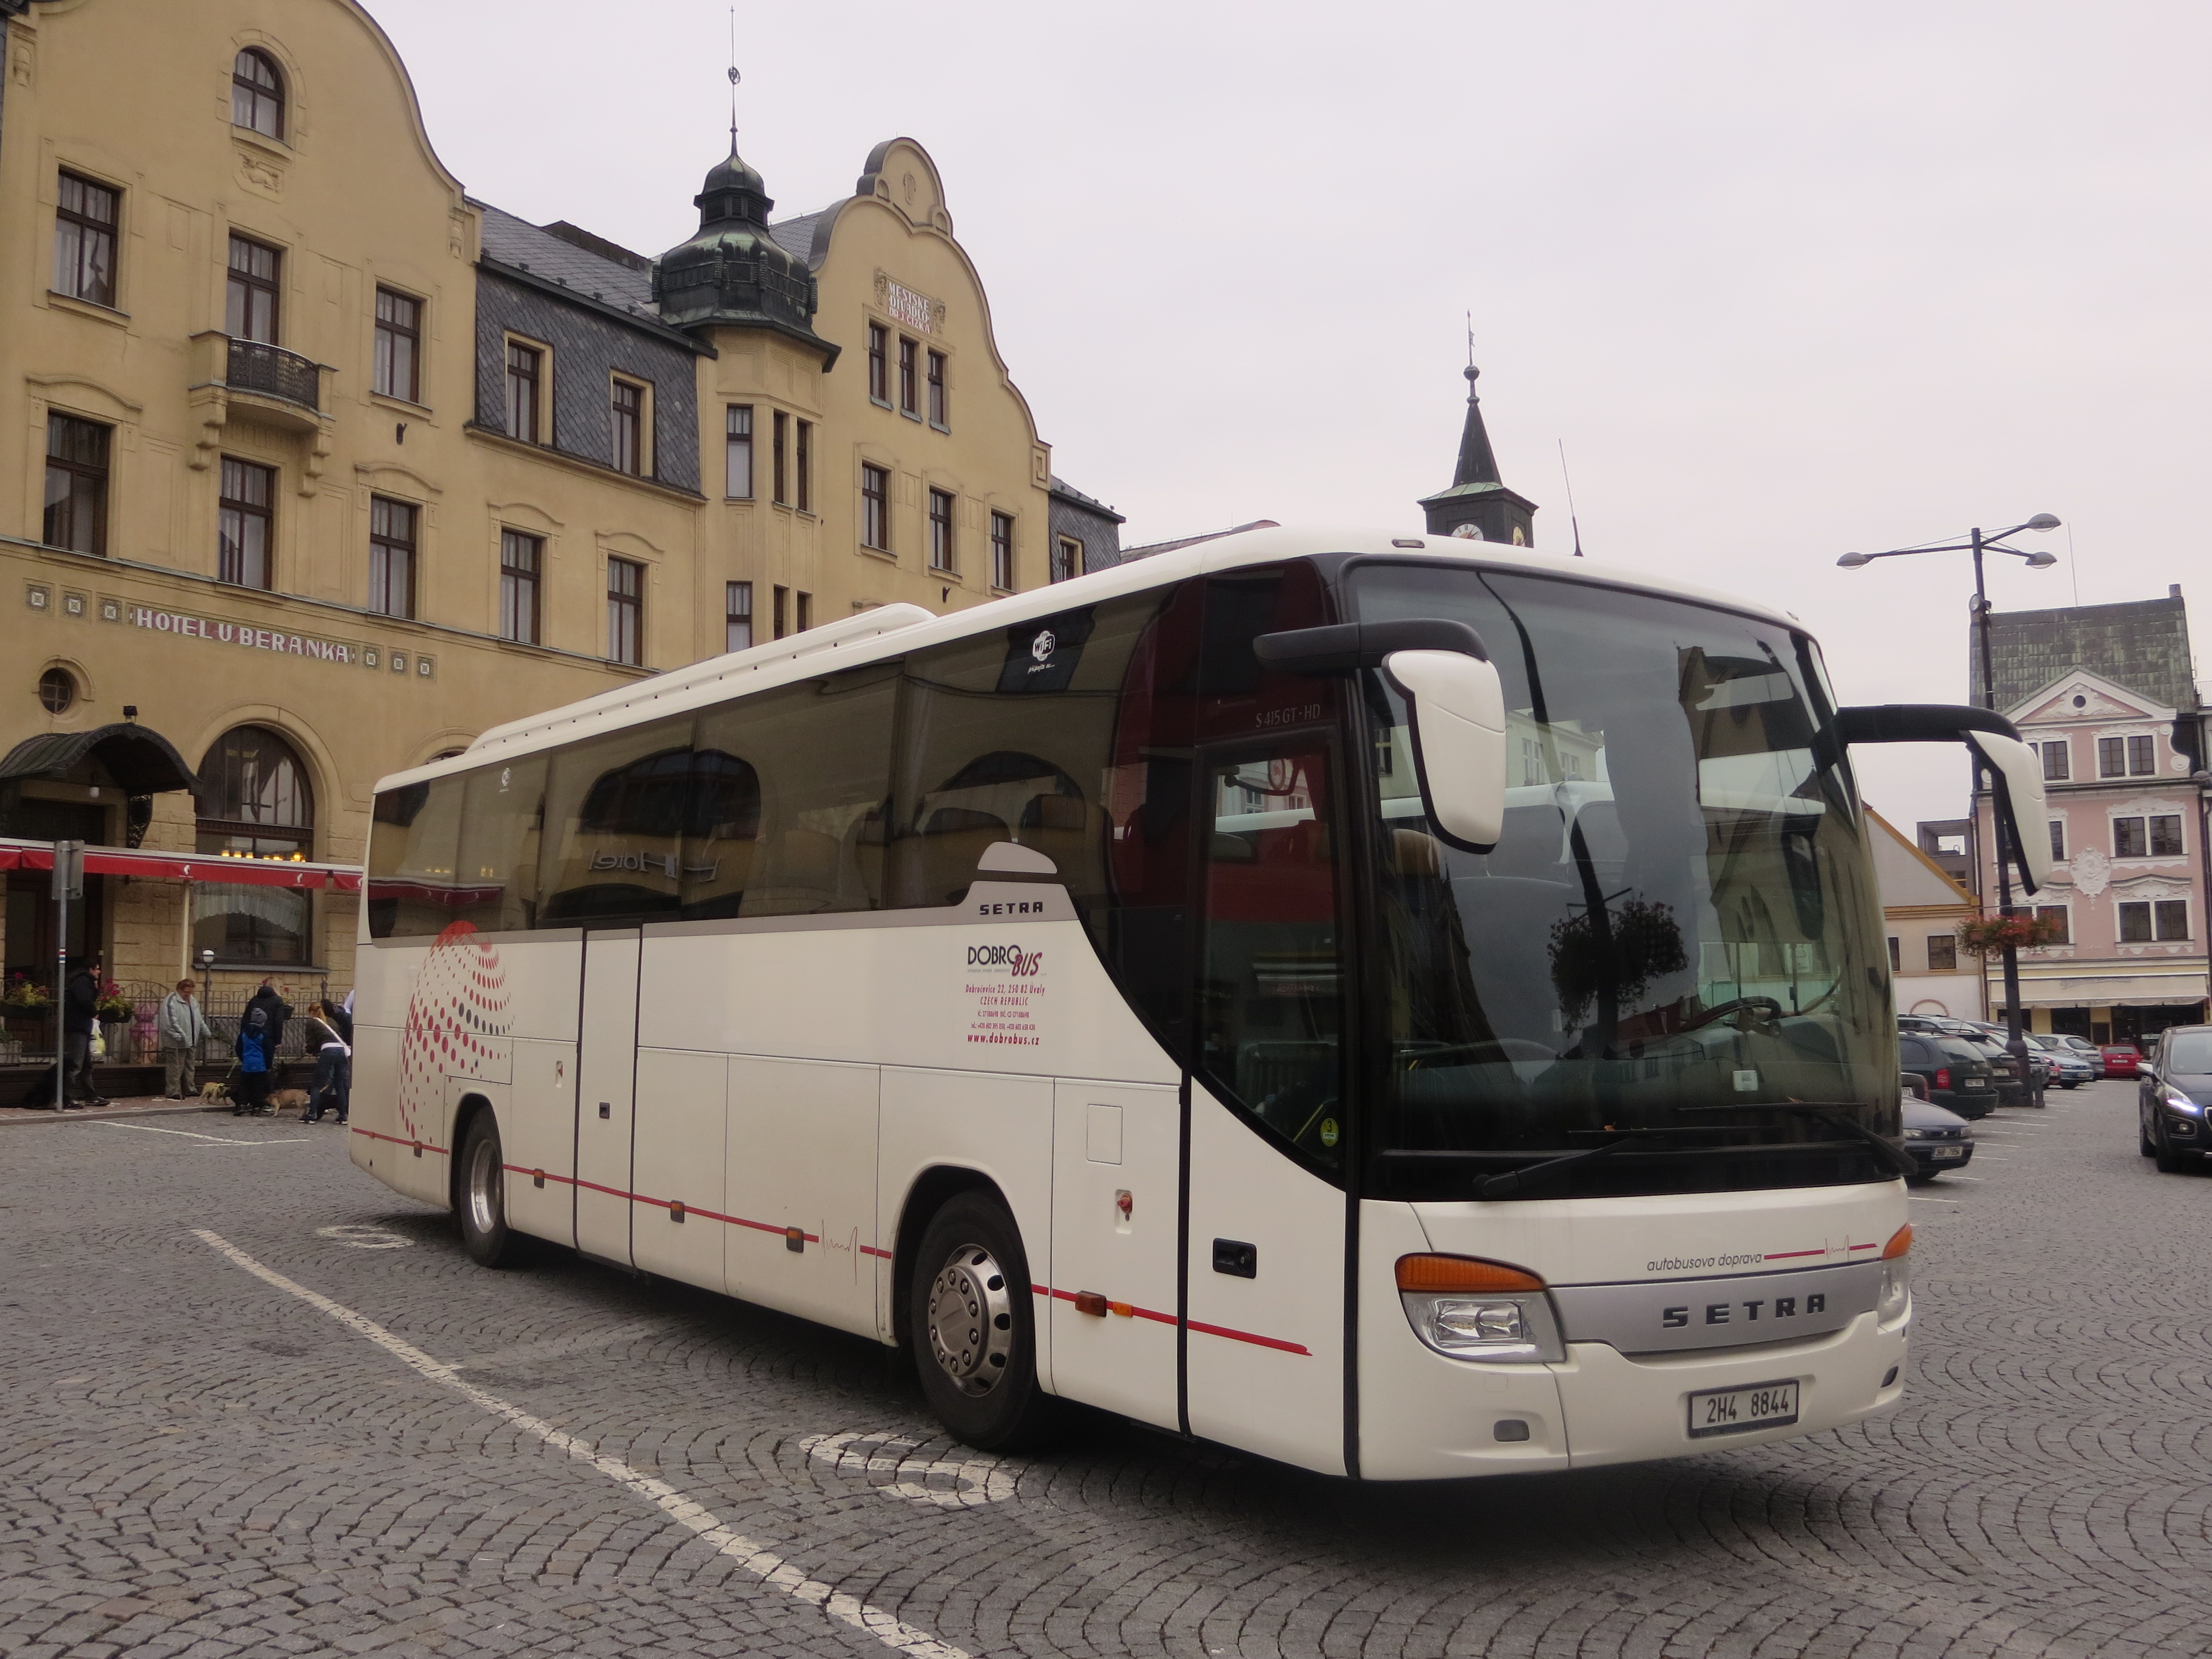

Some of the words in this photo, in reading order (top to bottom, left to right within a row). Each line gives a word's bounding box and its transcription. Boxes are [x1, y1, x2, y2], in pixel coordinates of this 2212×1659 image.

[889, 295, 928, 322] DIVADLO
[137, 608, 213, 639] HOTEL
[218, 623, 232, 641] U
[1256, 713, 1262, 728] S
[1264, 710, 1280, 726] 415
[979, 901, 1043, 915] SETRA
[998, 984, 1006, 994] 22,
[1008, 984, 1019, 994] 250
[1020, 984, 1028, 994] 82
[1030, 982, 1045, 996] Úvaly
[980, 997, 998, 1005] CZECH
[1000, 997, 1029, 1006] REPUBLIC
[967, 1032, 1040, 1045] www.dobrobus.cz
[1718, 1253, 1762, 1268] doprava
[1662, 1293, 1825, 1328] SETRA
[1707, 1395, 1738, 1423] 2H4
[1751, 1388, 1789, 1417] 8844
